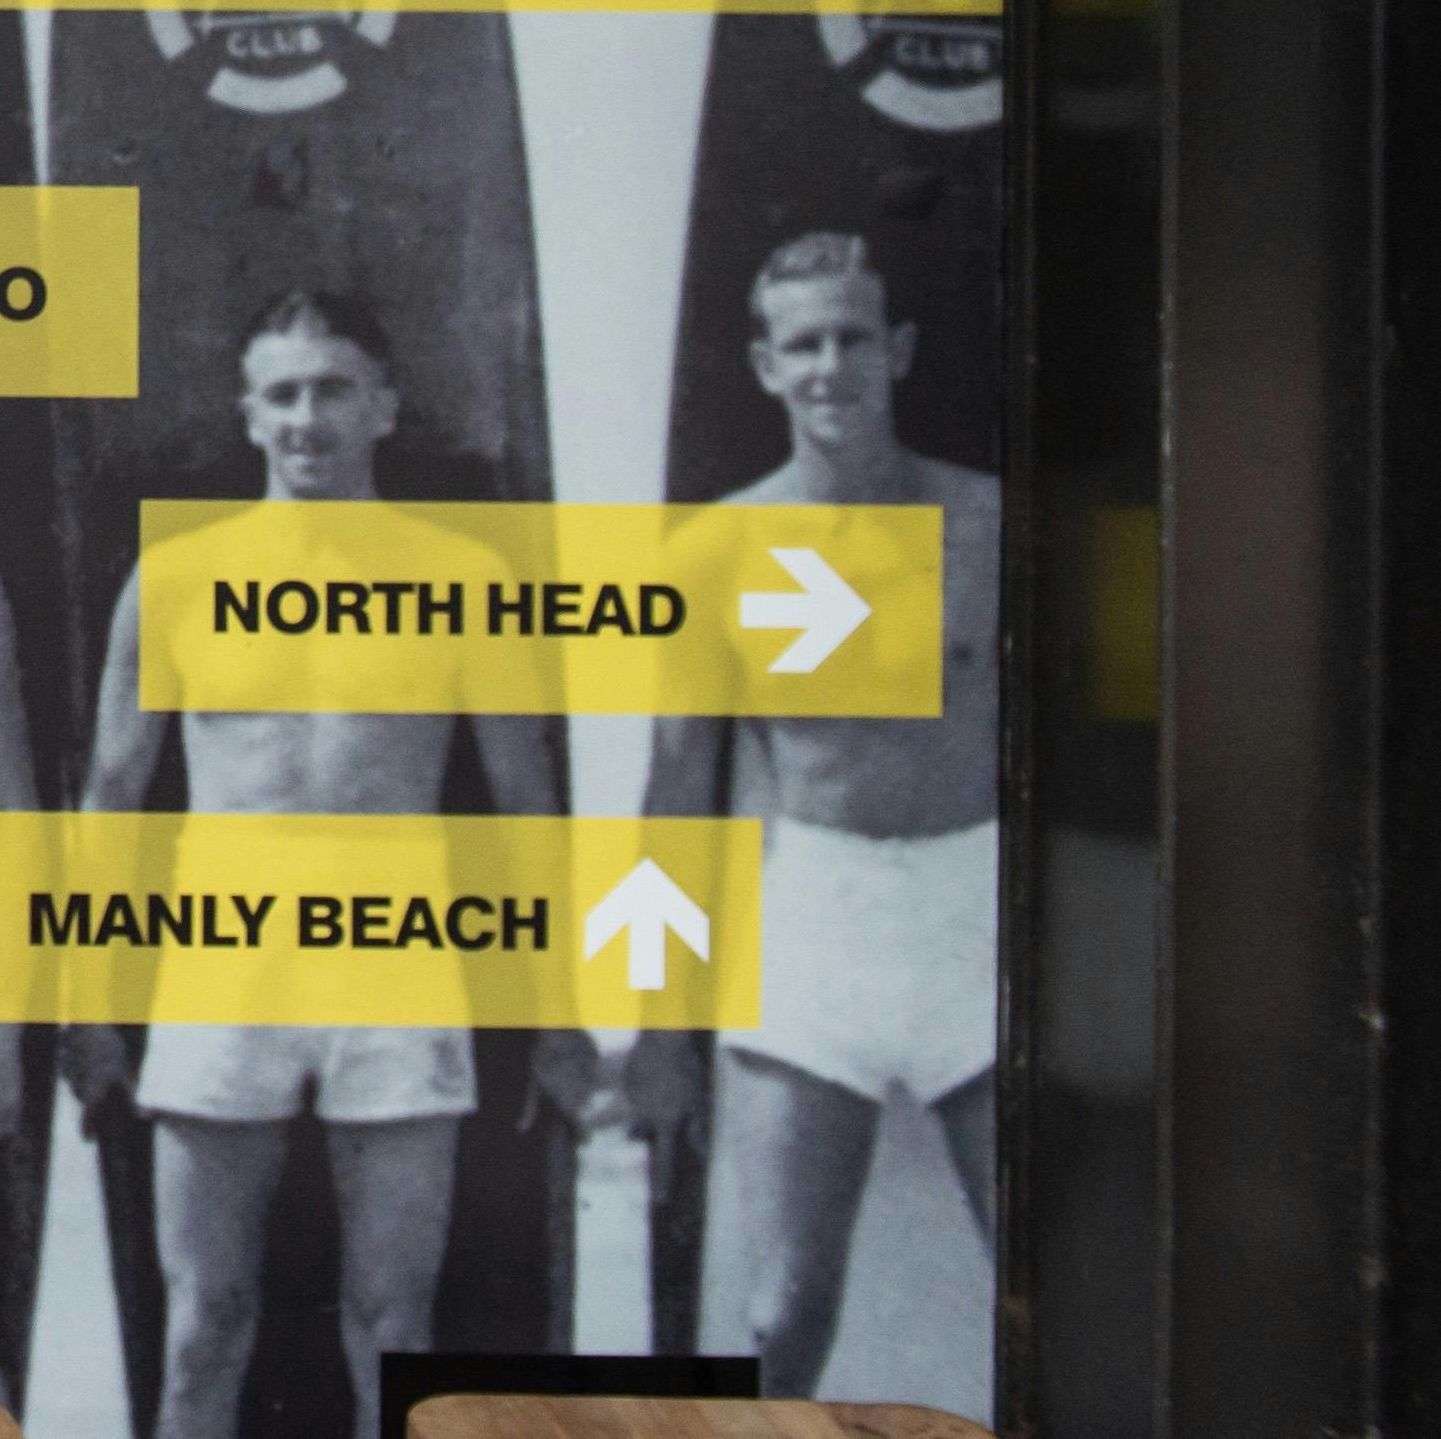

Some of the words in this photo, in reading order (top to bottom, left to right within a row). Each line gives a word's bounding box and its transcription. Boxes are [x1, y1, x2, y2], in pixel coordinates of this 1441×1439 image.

[226, 26, 324, 60] CLUB
[213, 580, 464, 636] NORTH
[486, 583, 688, 637] HEAD
[28, 892, 278, 948] MANLY
[297, 896, 549, 951] BEACH
